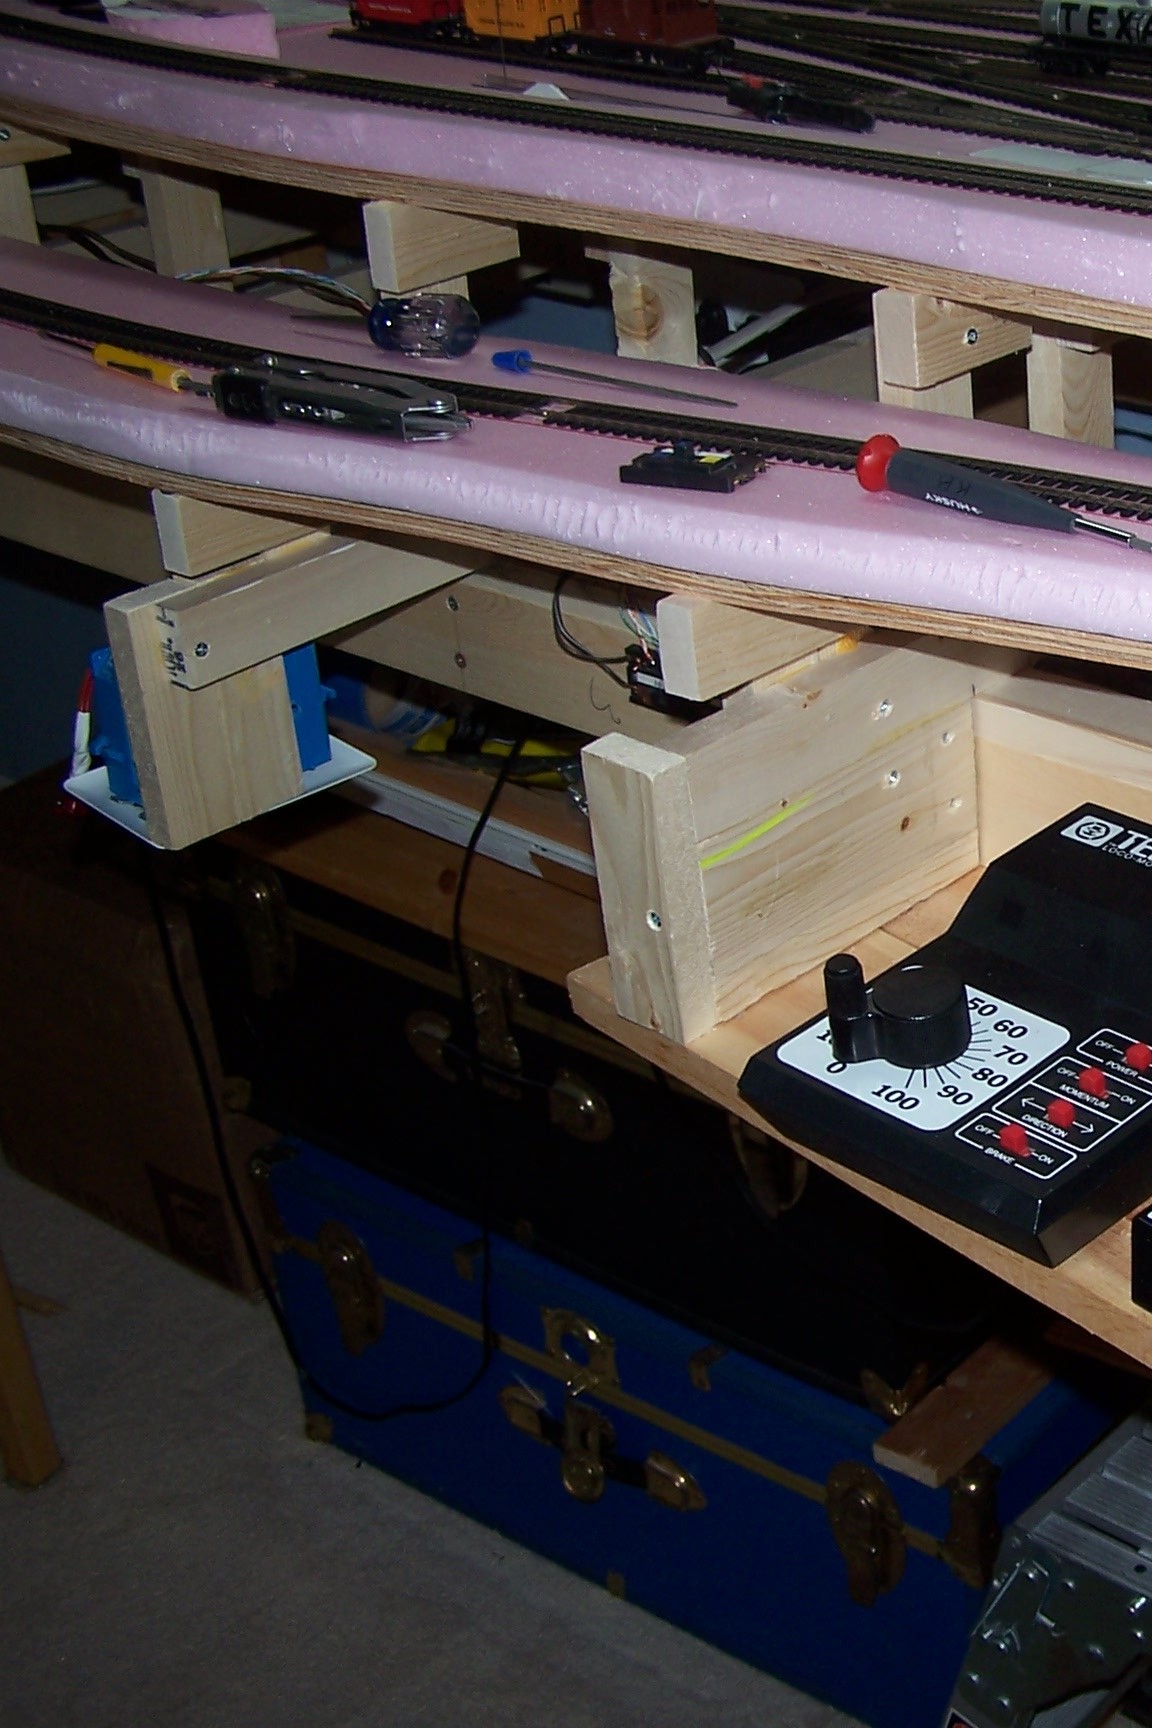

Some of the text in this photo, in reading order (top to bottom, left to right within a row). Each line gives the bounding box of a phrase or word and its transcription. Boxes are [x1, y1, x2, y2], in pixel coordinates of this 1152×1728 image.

[925, 492, 971, 512] HUSKY
[967, 997, 999, 1017] 50
[816, 1029, 833, 1045] 1
[993, 1019, 1028, 1039] 60
[1095, 1038, 1115, 1051] OFF
[993, 1045, 1029, 1066] 70
[826, 1061, 848, 1074] 0
[972, 1067, 1009, 1088] 80
[1056, 1066, 1077, 1079] OFF
[1105, 1058, 1139, 1079] POWER
[871, 1084, 920, 1111] 100
[937, 1085, 974, 1106] 90
[1059, 1083, 1110, 1109] MOMENTUM
[1120, 1094, 1137, 1105] ON
[975, 1123, 995, 1137] OFF
[1021, 1113, 1069, 1139] DIRECTION
[984, 1146, 1016, 1165] BRAKE
[1037, 1153, 1055, 1165] ON
